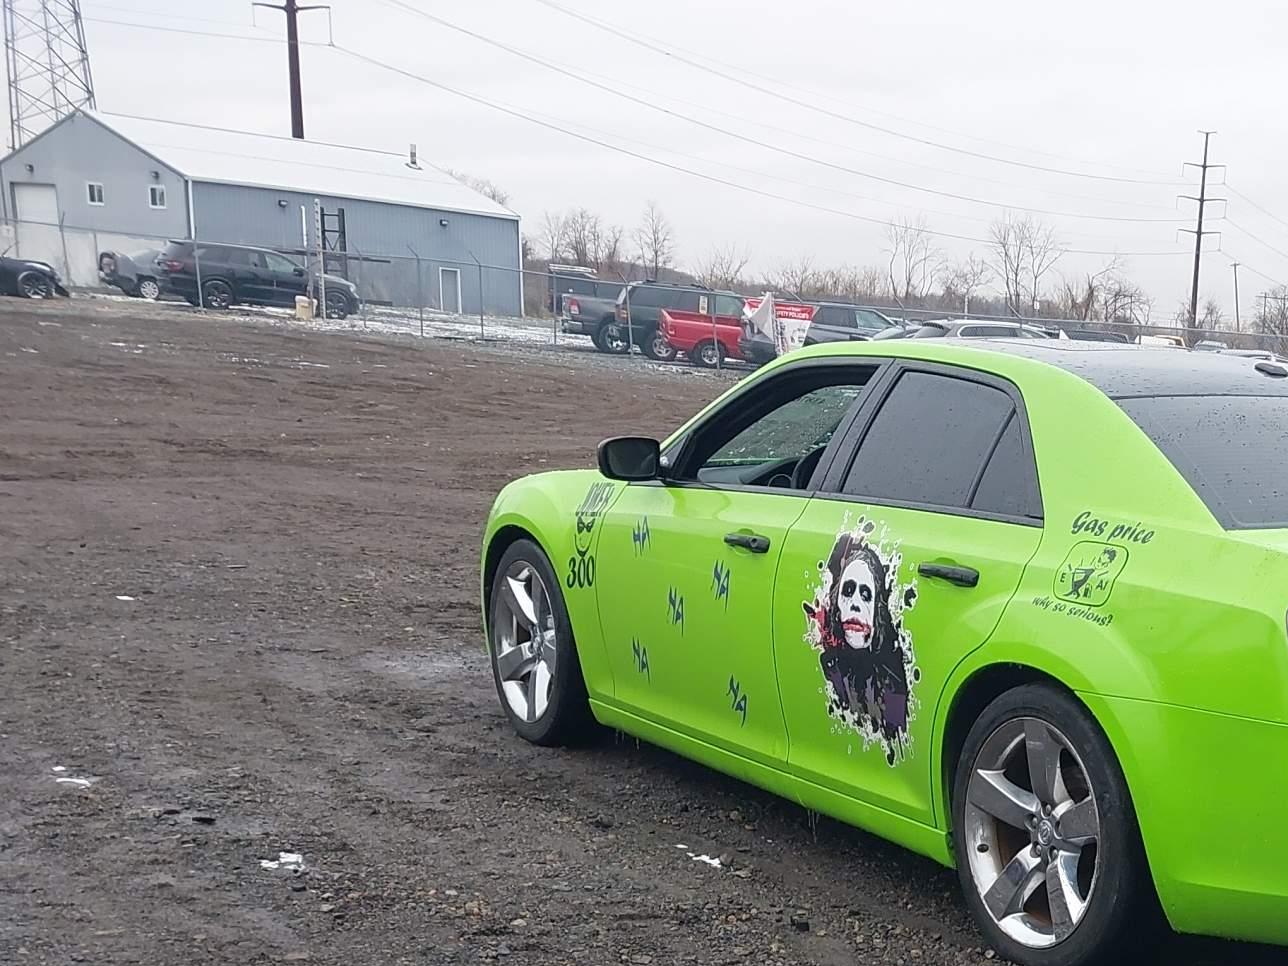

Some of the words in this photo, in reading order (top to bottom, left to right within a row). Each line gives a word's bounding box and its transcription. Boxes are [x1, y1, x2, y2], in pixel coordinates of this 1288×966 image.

[1071, 511, 1108, 536] Gas
[1106, 522, 1155, 544] price
[566, 555, 595, 589] 300
[1031, 595, 1054, 611] why
[1052, 602, 1067, 612] so
[1066, 606, 1114, 627] serious?
